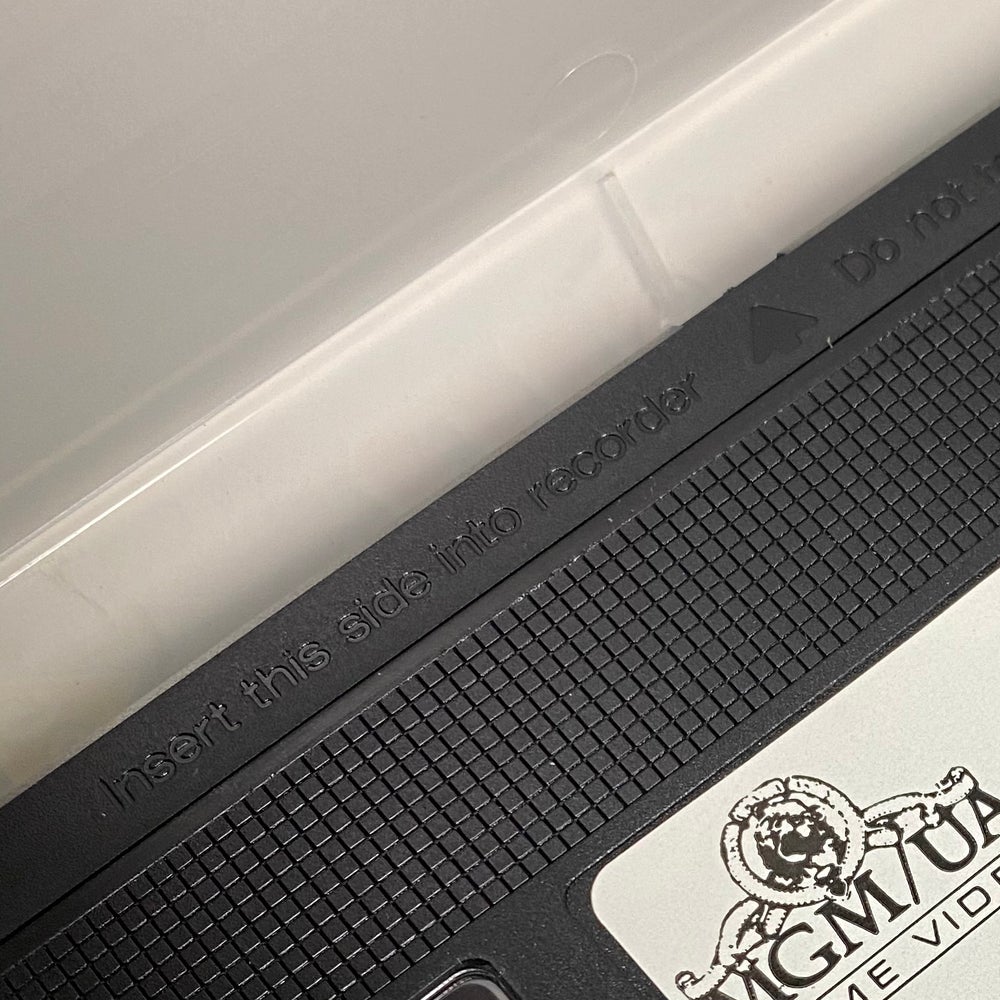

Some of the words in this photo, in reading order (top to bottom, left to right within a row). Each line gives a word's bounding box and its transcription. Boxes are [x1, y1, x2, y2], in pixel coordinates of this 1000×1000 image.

[834, 237, 899, 285] Do
[905, 180, 977, 240] not
[99, 701, 242, 809] Insert
[240, 641, 331, 709] this
[337, 570, 432, 643] side
[428, 507, 522, 575] into
[527, 371, 701, 510] recorder
